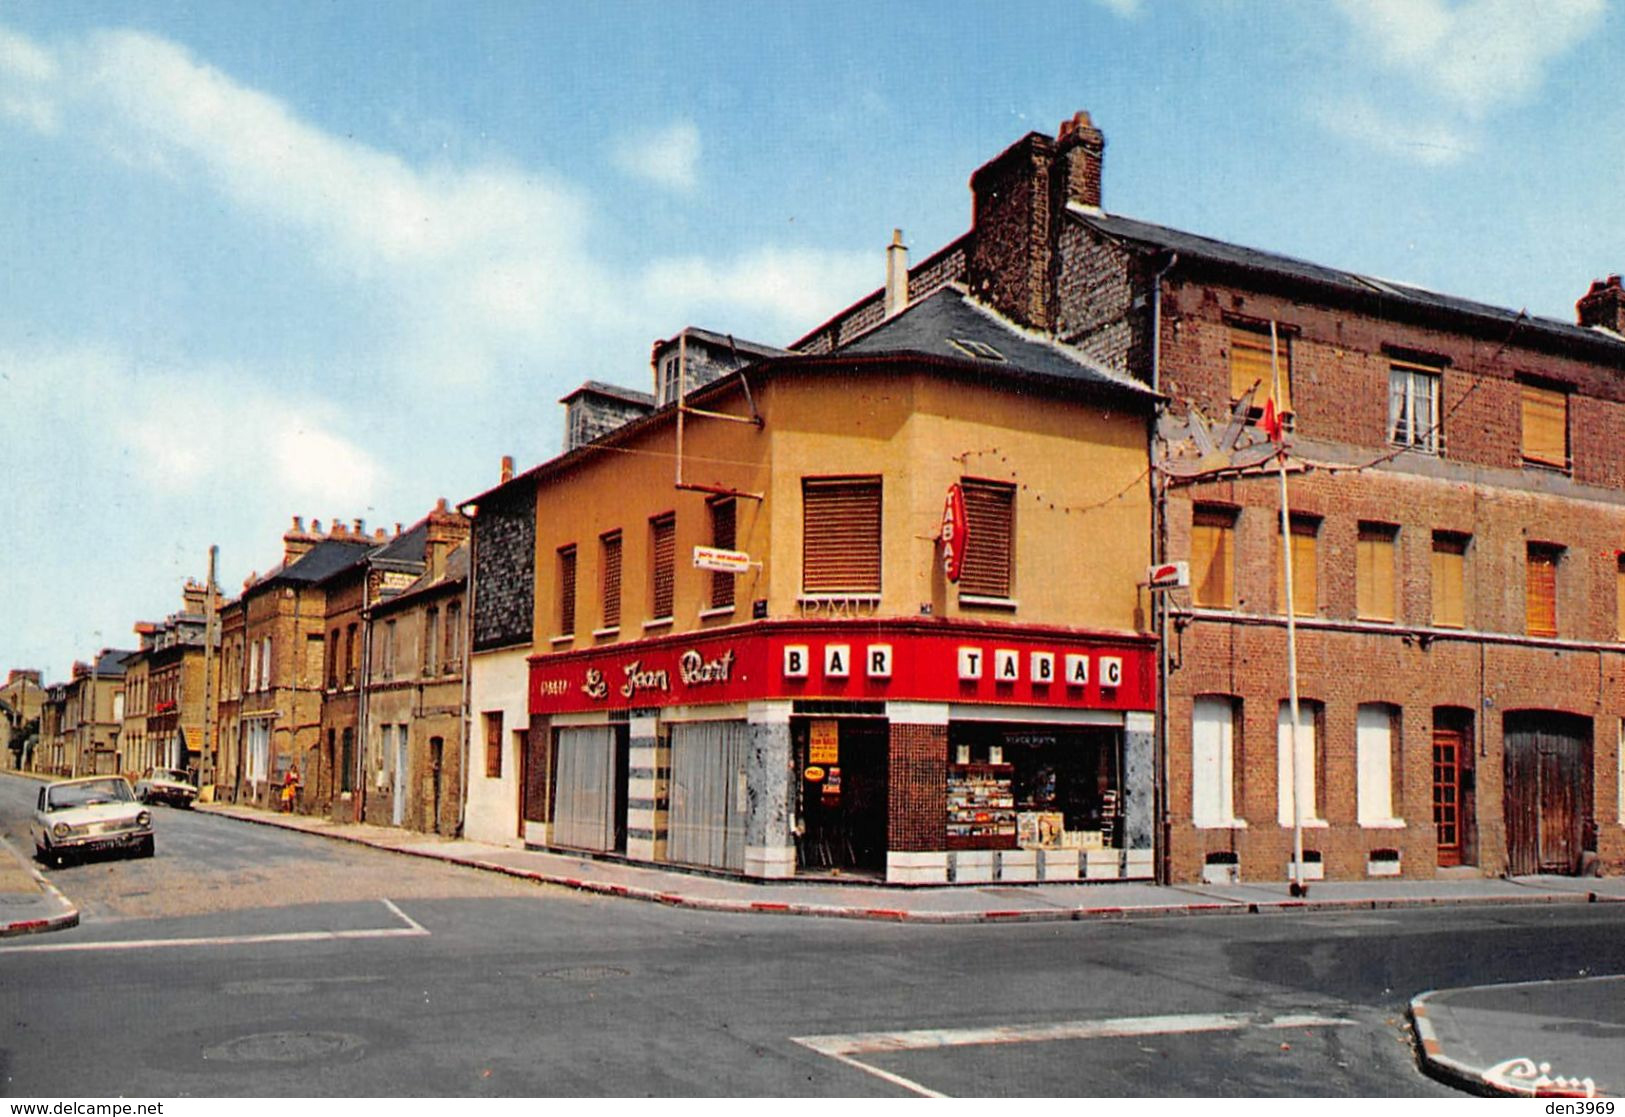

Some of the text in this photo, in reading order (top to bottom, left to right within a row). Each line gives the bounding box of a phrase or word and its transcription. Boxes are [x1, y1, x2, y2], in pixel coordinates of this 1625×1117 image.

[943, 491, 954, 572] TABAC
[803, 599, 874, 618] PMU
[680, 649, 734, 684] Bart
[788, 651, 886, 673] BAR
[967, 654, 1119, 682] TABAC
